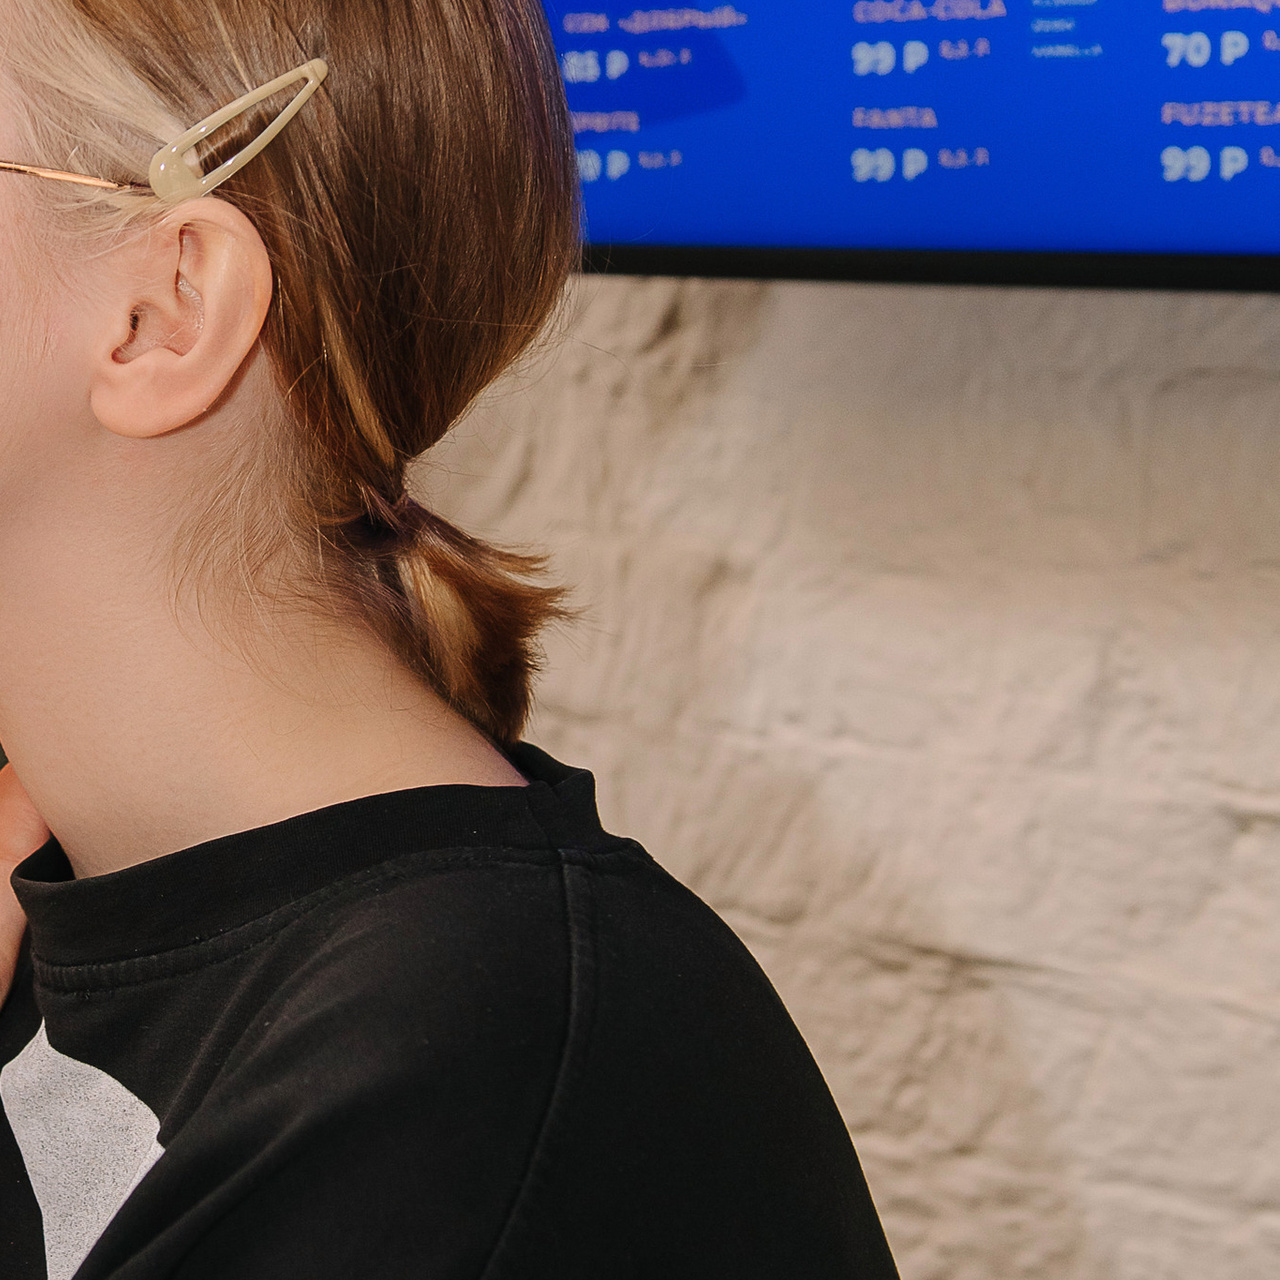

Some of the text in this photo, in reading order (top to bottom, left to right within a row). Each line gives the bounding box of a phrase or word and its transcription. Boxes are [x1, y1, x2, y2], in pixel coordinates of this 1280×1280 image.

[852, 41, 896, 76] 99
[1161, 32, 1211, 67] 70
[851, 148, 895, 183] 99
[1161, 146, 1211, 182] 99
